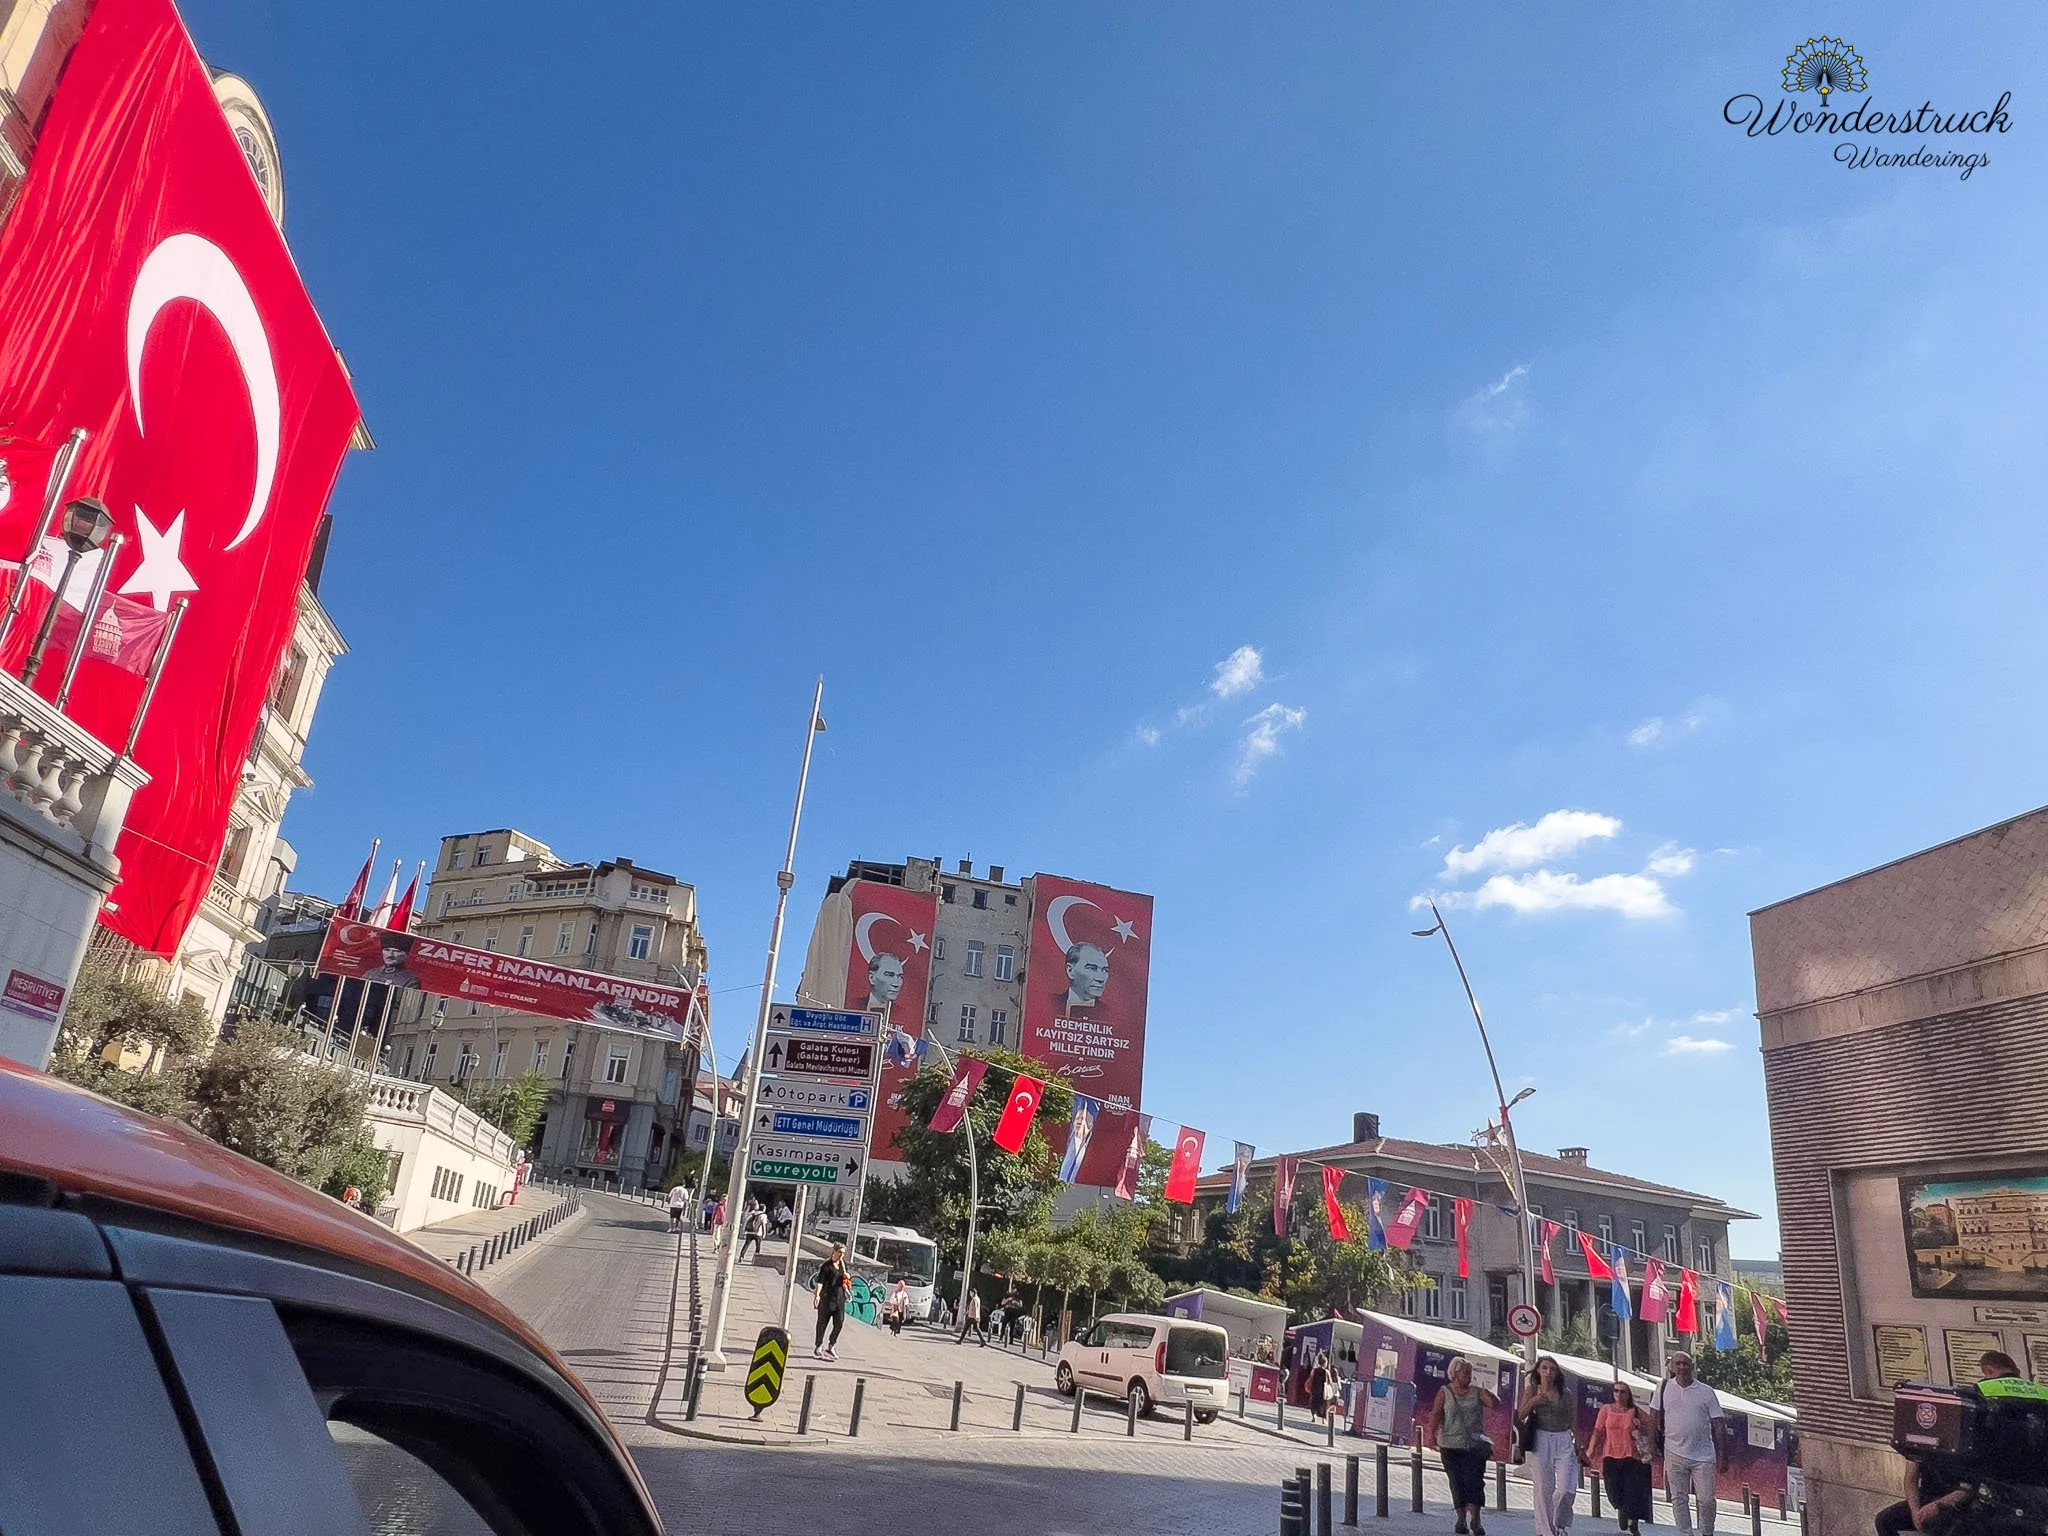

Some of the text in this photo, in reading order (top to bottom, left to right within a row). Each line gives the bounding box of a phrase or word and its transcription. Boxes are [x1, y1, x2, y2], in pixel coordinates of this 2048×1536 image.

[418, 942, 681, 1009] ZAFER İNANANLARINDIR
[466, 967, 492, 977] ZAFER
[11, 976, 60, 1000] MEŞRUTİYET
[1054, 1018, 1113, 1035] EGEMENLİK
[1035, 1027, 1130, 1049] KAYITSIZ ŞARTSIZ
[797, 1051, 860, 1064] (Galata Tower)
[800, 1042, 859, 1055] Galata Kulesi
[1049, 1041, 1115, 1059] MİLLETİNDİR
[786, 1060, 805, 1069] Galata
[777, 1086, 846, 1104] Otopark
[792, 1118, 814, 1130] Genel
[816, 1121, 859, 1136] Müdürlüğü
[756, 1143, 840, 1163] Kasımpaşa
[752, 1161, 837, 1179] Çevreyolu
